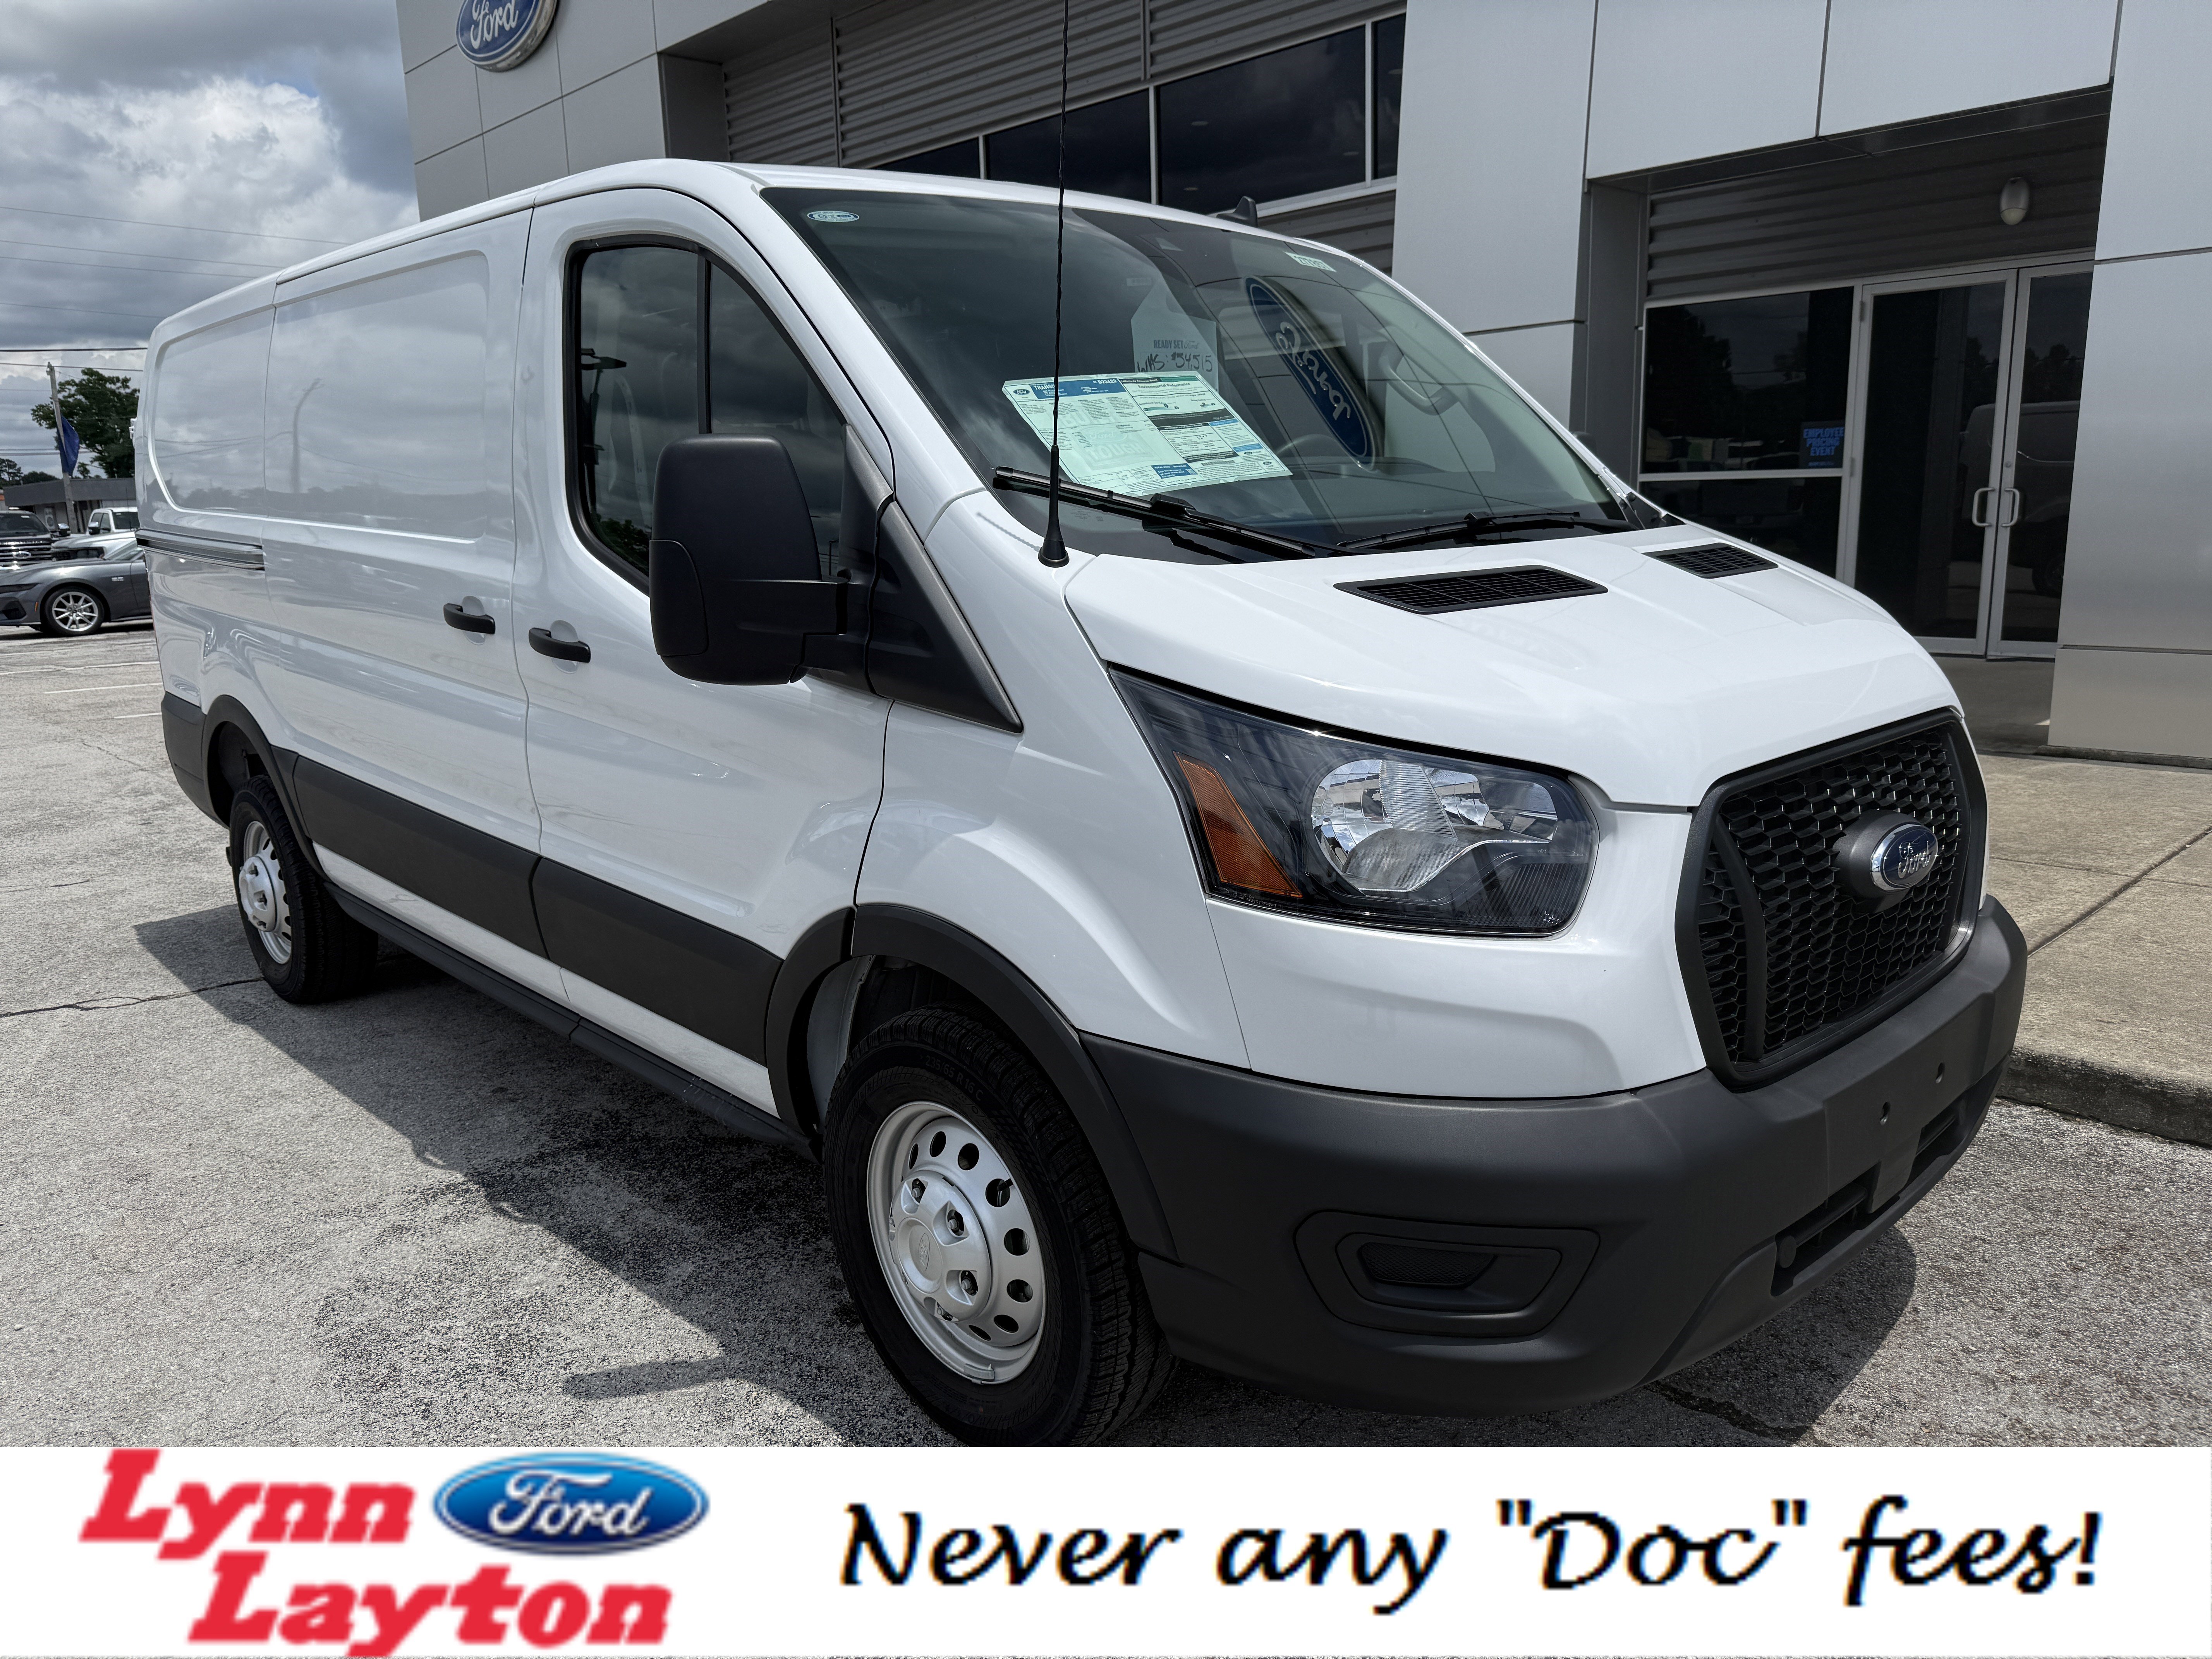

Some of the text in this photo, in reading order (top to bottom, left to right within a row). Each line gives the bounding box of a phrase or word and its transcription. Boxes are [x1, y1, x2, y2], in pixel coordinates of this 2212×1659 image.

[470, 0, 519, 49] Ford
[1154, 340, 1199, 349] READY SET Ford
[1171, 351, 1213, 372] $54,515
[1803, 427, 1844, 438] EMPLOYEE
[1806, 437, 1840, 447] PRICING
[1810, 446, 1836, 456] EVENT
[1897, 835, 1931, 879] Ford
[925, 1055, 955, 1078] 235/65
[957, 1072, 964, 1085] R
[964, 1078, 975, 1093] 16
